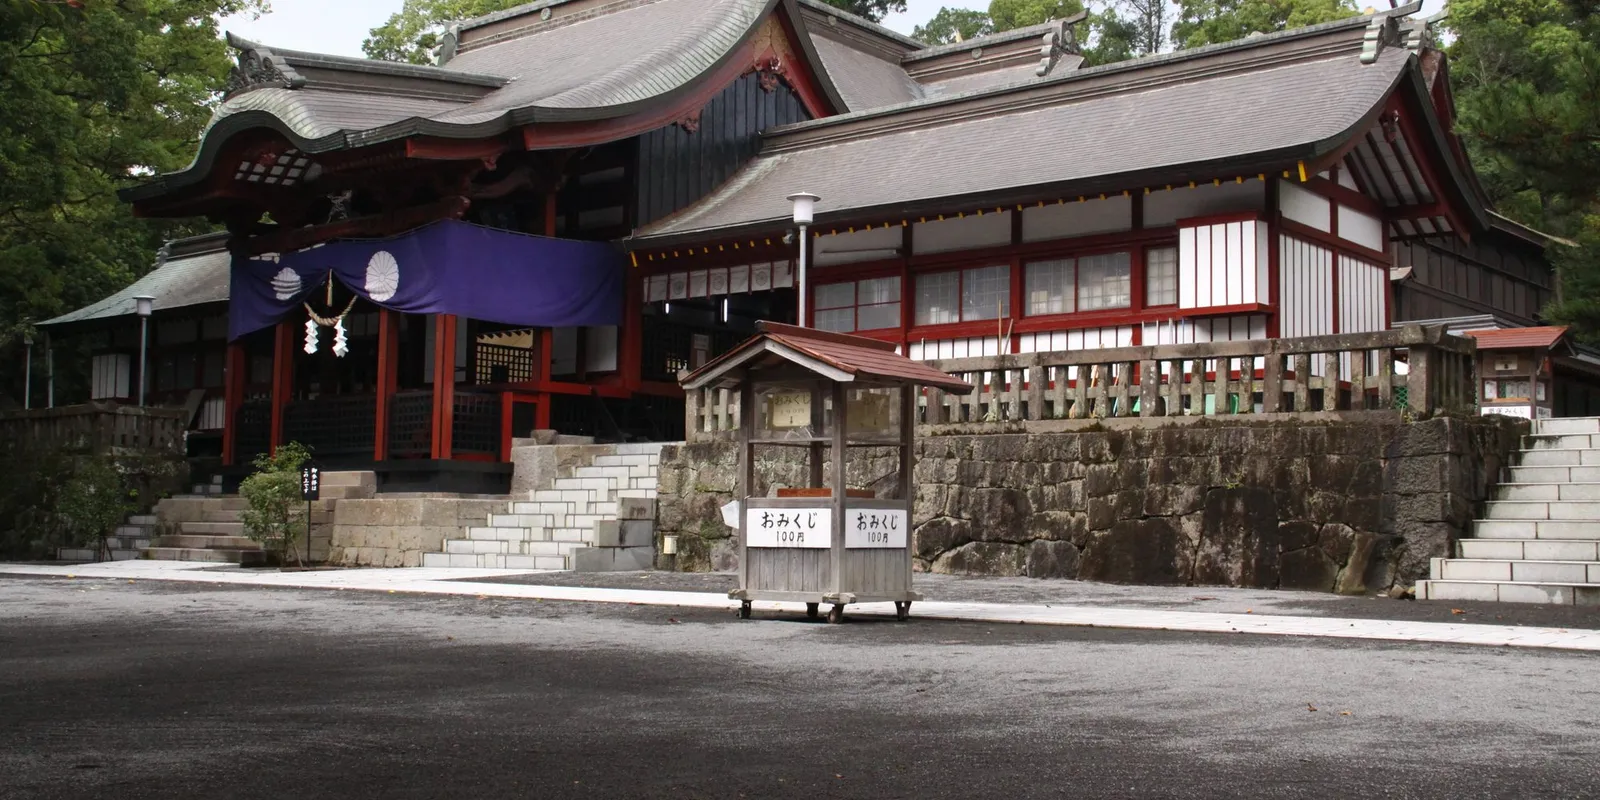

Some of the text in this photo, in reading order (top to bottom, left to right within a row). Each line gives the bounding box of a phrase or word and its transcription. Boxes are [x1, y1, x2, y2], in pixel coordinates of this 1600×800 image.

[761, 511, 818, 529] おみくじ
[856, 512, 898, 530] おみくじ
[776, 531, 804, 542] 100円
[867, 532, 889, 543] 100円
